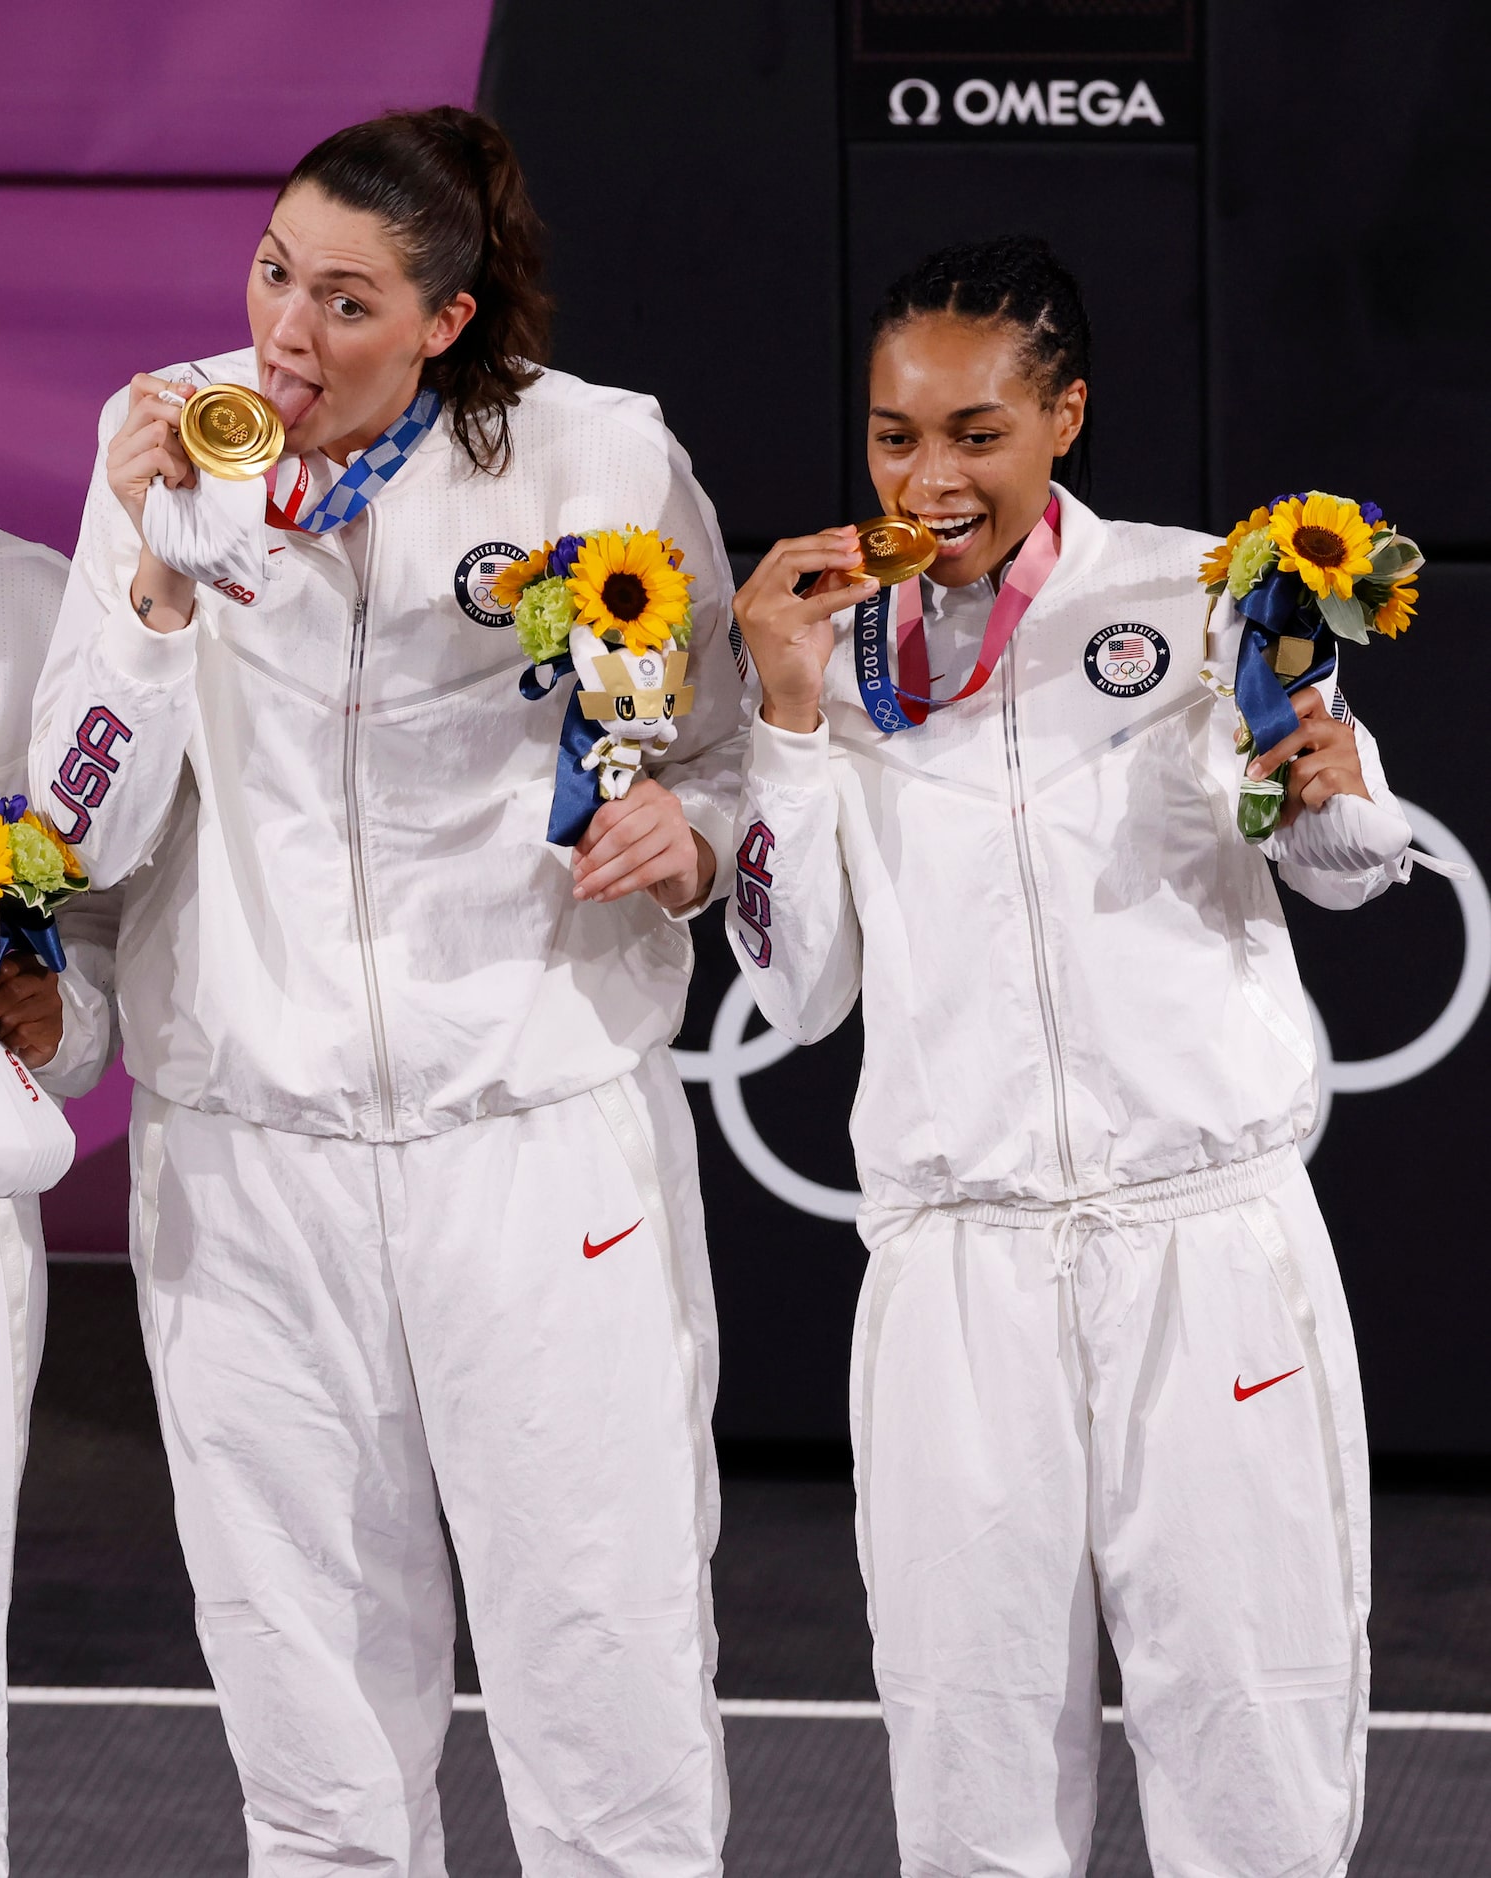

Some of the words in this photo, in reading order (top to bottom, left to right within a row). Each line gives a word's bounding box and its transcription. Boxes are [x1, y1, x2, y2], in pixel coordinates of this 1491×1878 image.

[953, 78, 1165, 126] OMEGA
[465, 545, 495, 565] UNITED
[212, 577, 255, 605] USA
[466, 603, 501, 624] OLYMPIC
[862, 594, 880, 641] OKYO
[1093, 625, 1122, 645] UNITED
[1128, 625, 1158, 640] STATES
[862, 644, 882, 692] 2020
[1097, 679, 1135, 694] OLYMPIC
[1139, 673, 1159, 690] TEAM
[50, 705, 133, 844] USA
[736, 820, 775, 969] USA
[5, 1049, 39, 1102] USA
